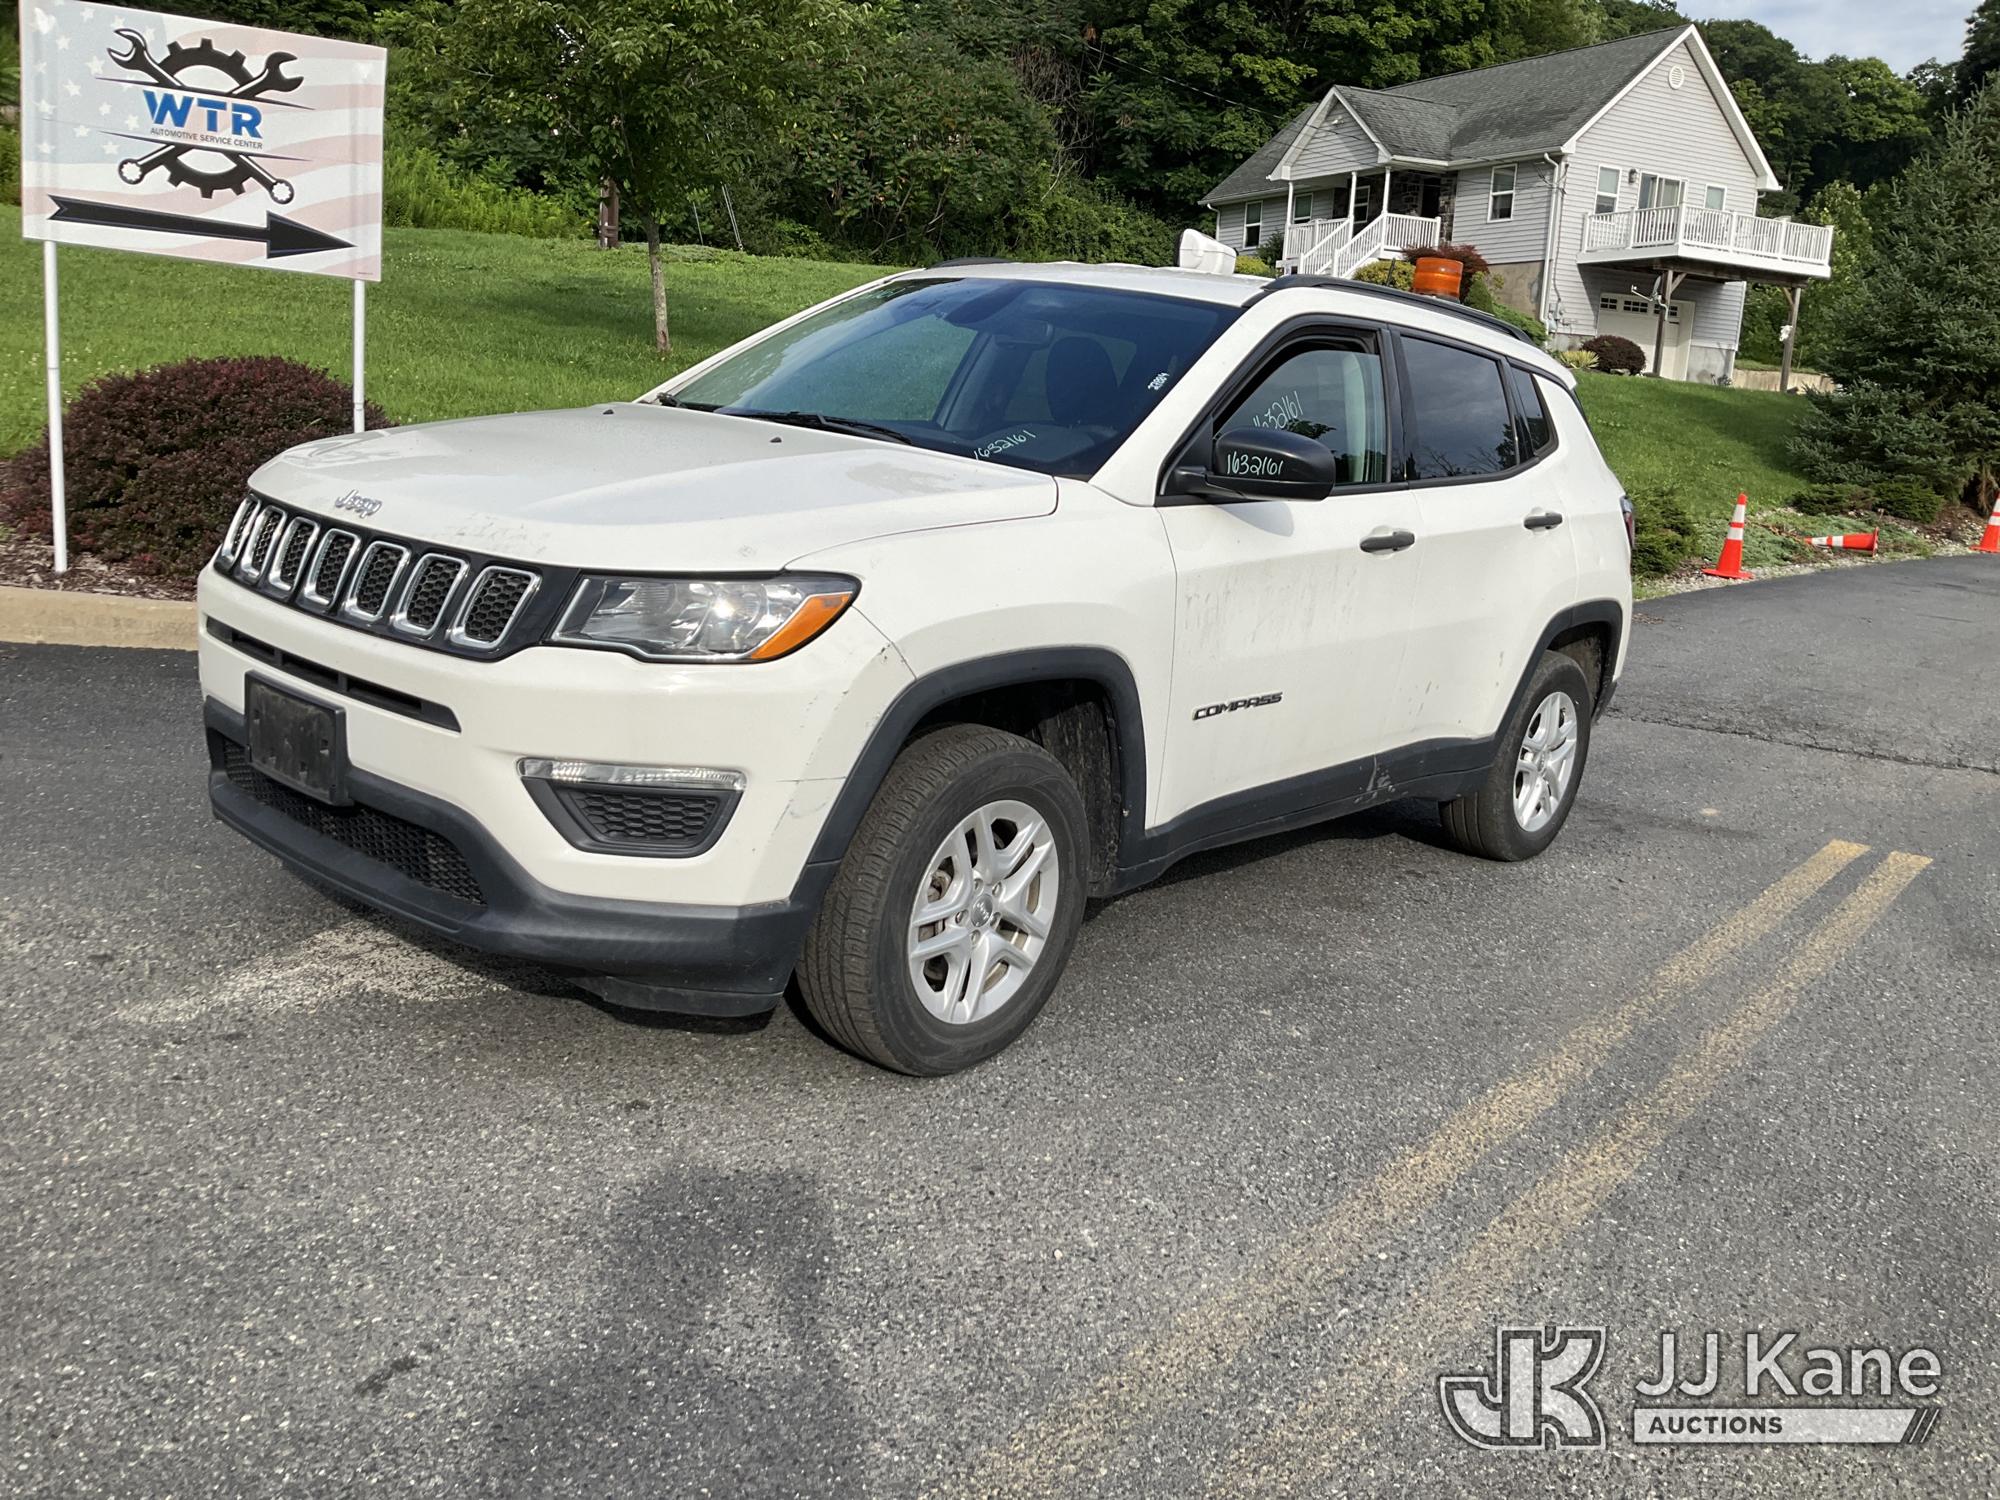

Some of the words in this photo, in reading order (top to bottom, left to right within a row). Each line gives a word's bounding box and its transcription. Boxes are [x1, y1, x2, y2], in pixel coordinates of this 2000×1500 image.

[143, 90, 263, 139] WTR
[150, 127, 198, 141] AUTOMOTIVE
[199, 134, 232, 145] SERVICE
[233, 139, 263, 150] CENTER
[973, 429, 1037, 461] 1632161
[1226, 450, 1284, 476] 1632161
[334, 489, 383, 519] Jeep
[1192, 692, 1283, 721] COMPASS
